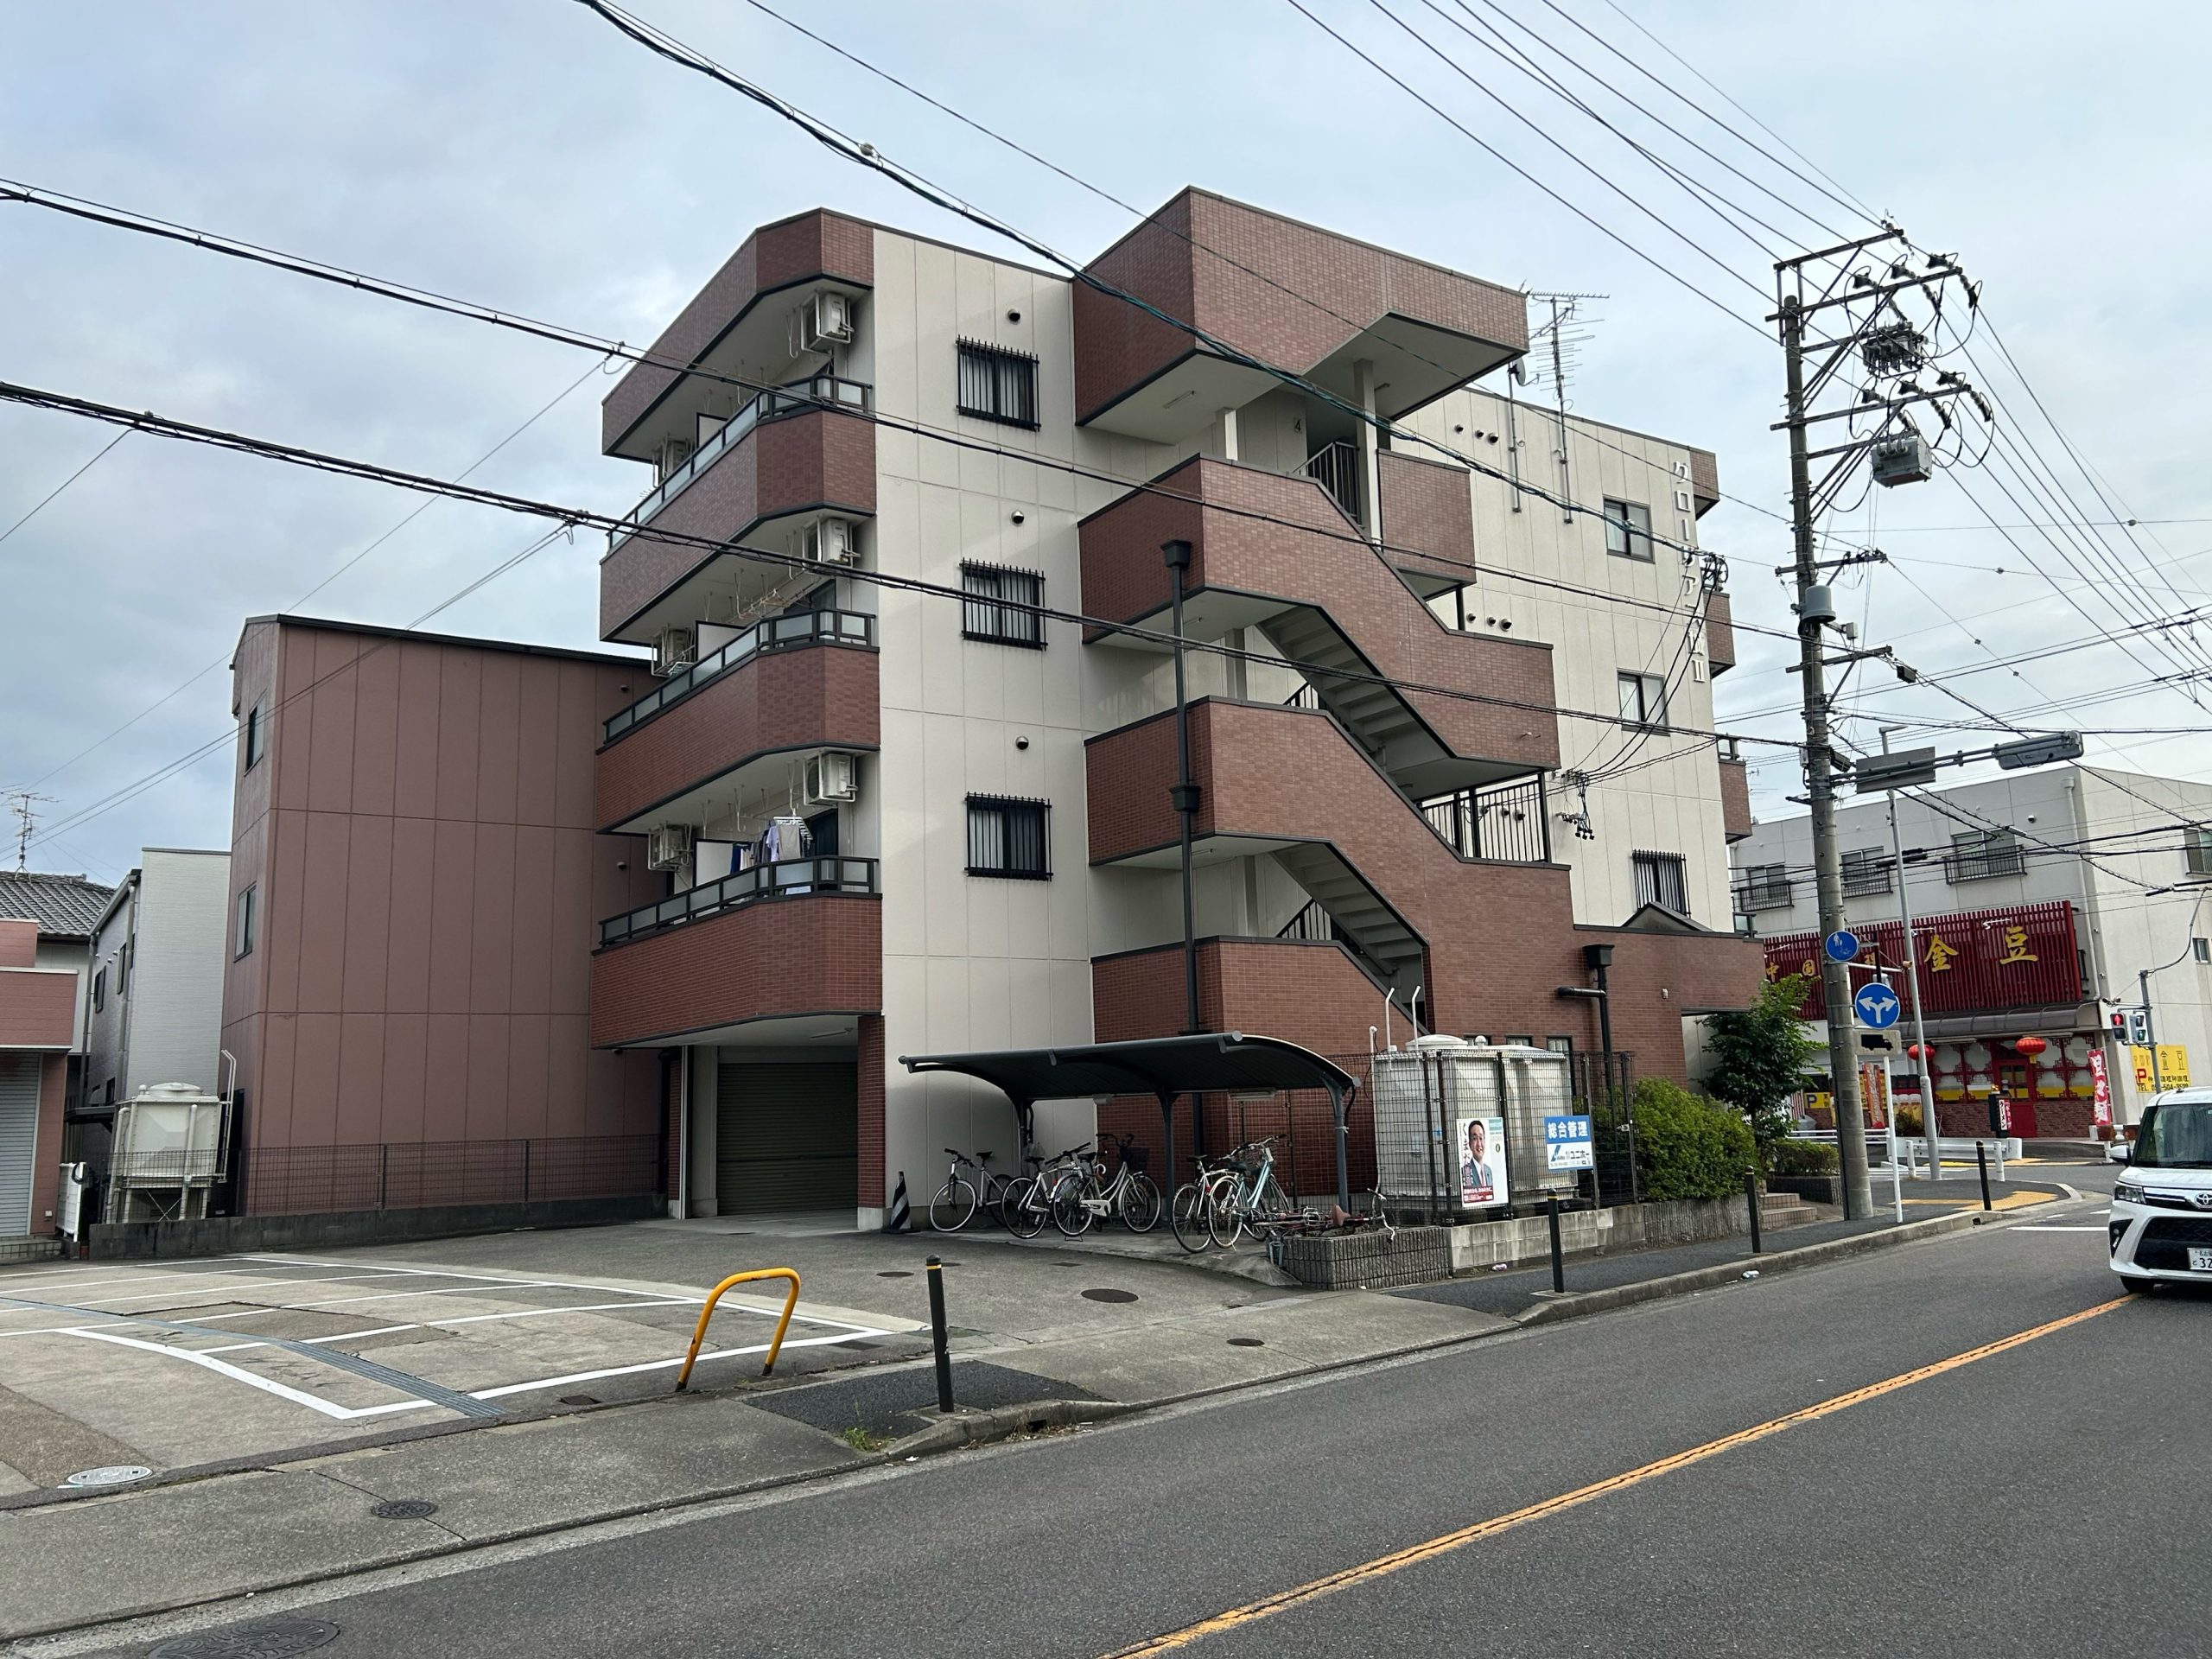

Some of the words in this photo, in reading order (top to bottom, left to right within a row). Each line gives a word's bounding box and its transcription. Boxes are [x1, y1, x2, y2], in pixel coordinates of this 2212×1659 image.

[1923, 926, 2039, 972] 金豆
[1806, 1094, 1817, 1108] P
[1548, 1120, 1588, 1139] 総合管理
